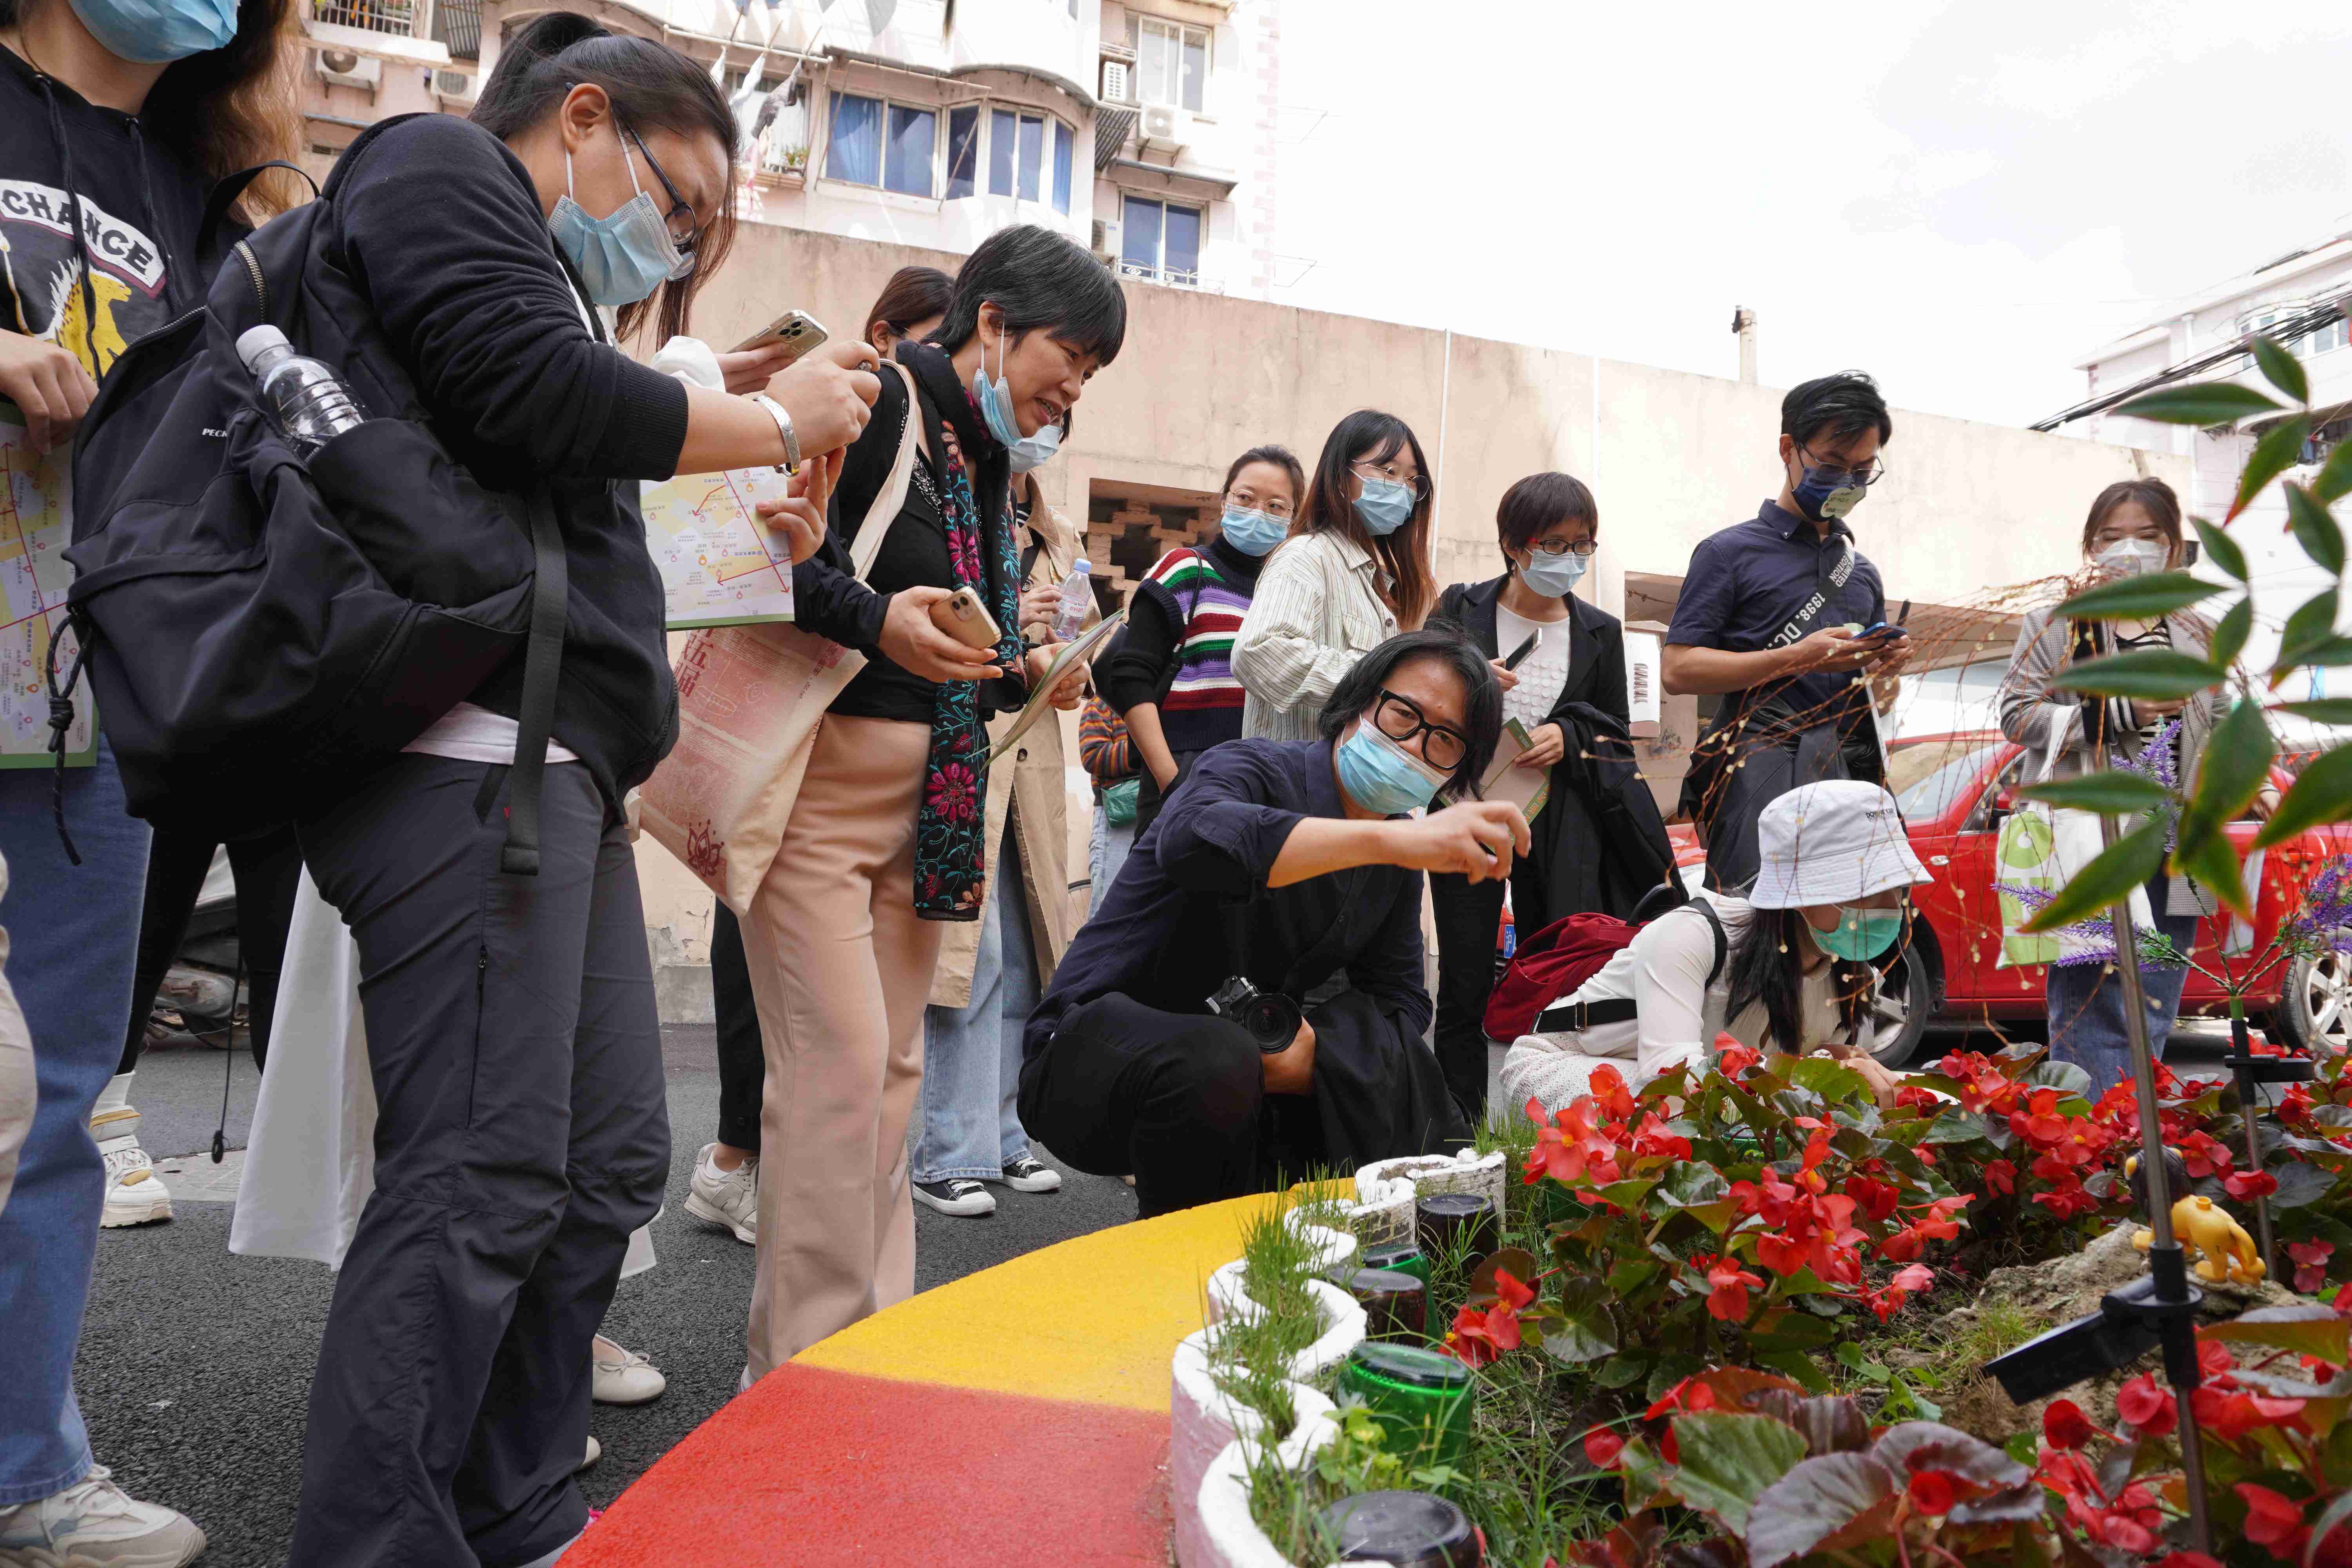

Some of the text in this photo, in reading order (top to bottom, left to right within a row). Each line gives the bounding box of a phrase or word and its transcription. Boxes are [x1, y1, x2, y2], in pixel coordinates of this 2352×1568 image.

[1, 189, 153, 275] CHANCE
[1829, 555, 1849, 582] EDITION
[1794, 592, 1826, 621] 1998.
